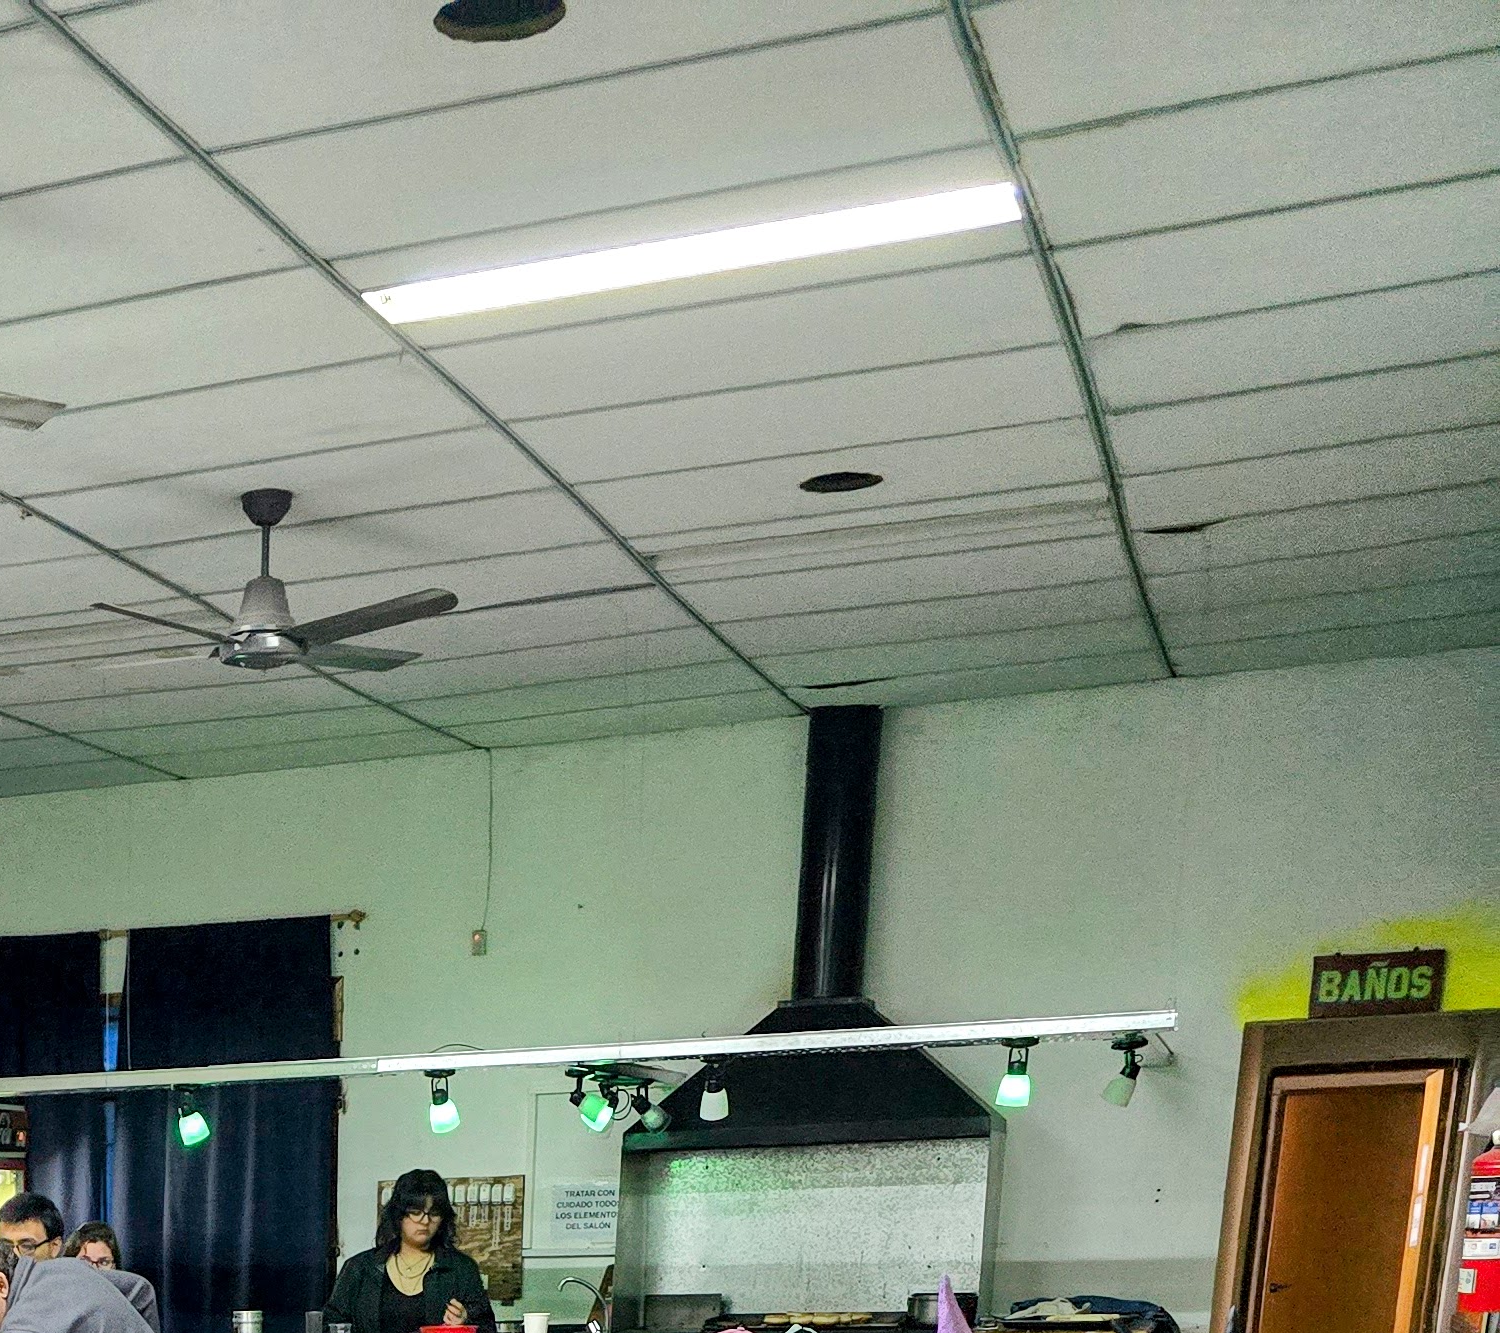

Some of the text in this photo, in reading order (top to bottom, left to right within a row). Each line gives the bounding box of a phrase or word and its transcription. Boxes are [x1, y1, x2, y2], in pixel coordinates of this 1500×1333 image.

[1318, 960, 1434, 1003] BAÑOS
[565, 1189, 616, 1198] TRATAR CON
[556, 1200, 619, 1209] CUIDADO TODO
[555, 1211, 618, 1220] LOS ELEMENTO
[565, 1221, 611, 1230] DEL SALÓN
